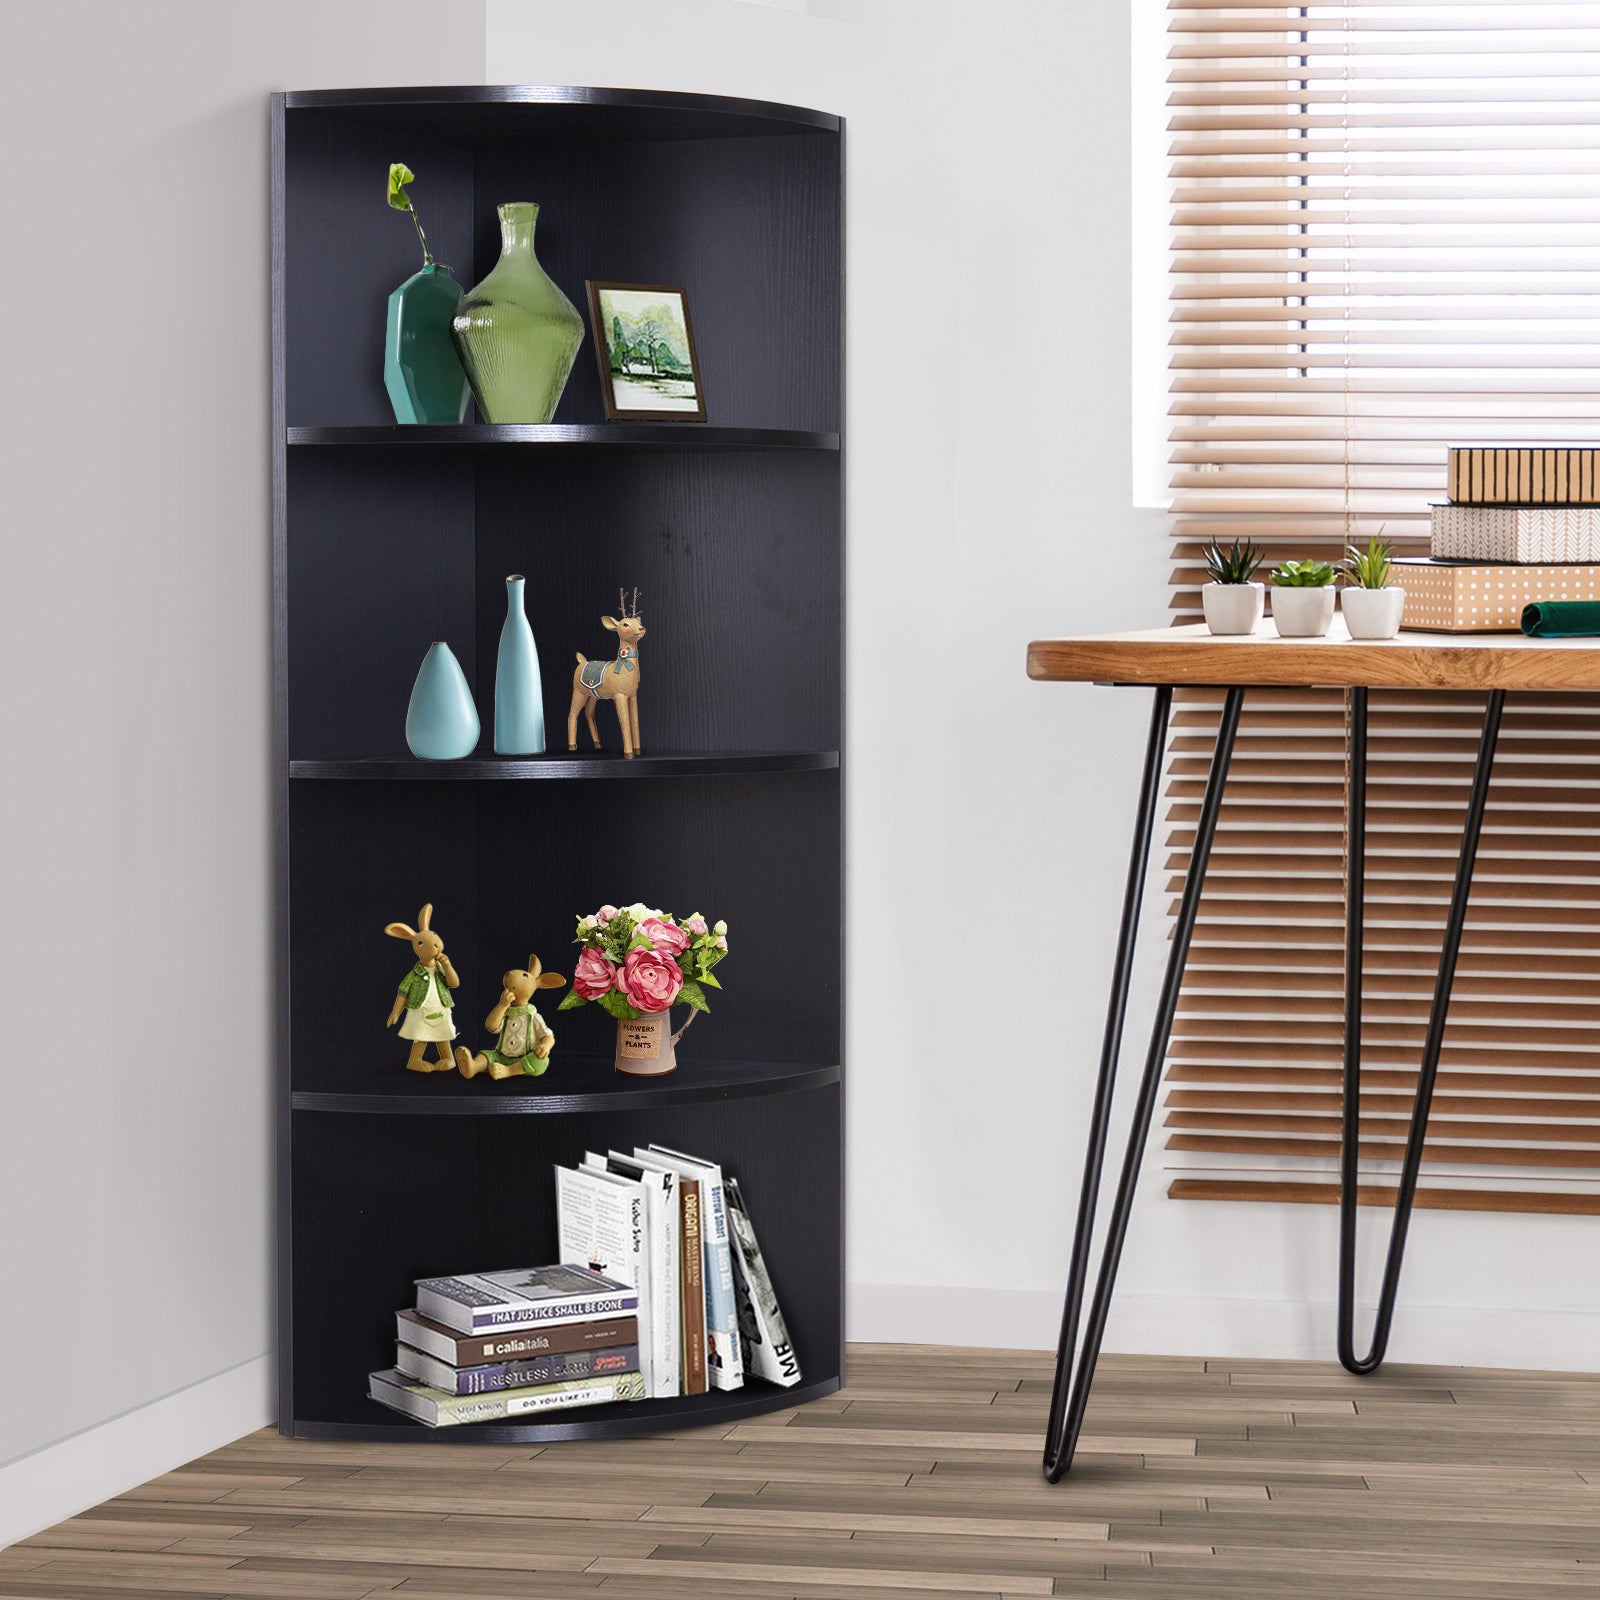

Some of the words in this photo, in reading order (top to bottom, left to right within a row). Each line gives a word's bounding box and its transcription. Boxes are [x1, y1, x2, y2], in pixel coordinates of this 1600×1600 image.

[623, 1024, 655, 1033] FLOWERS
[625, 1040, 652, 1049] PLANTS
[714, 1214, 726, 1239] Smart
[491, 1312, 516, 1324] THAT
[515, 1306, 554, 1321] JUSTICE
[554, 1304, 583, 1317] SHALL
[584, 1302, 597, 1313] BE
[597, 1299, 623, 1311] DONE
[490, 1367, 549, 1387] RESTLESS
[522, 1400, 536, 1408] DO
[540, 1396, 557, 1405] YOU
[559, 1393, 578, 1404] LIKE
